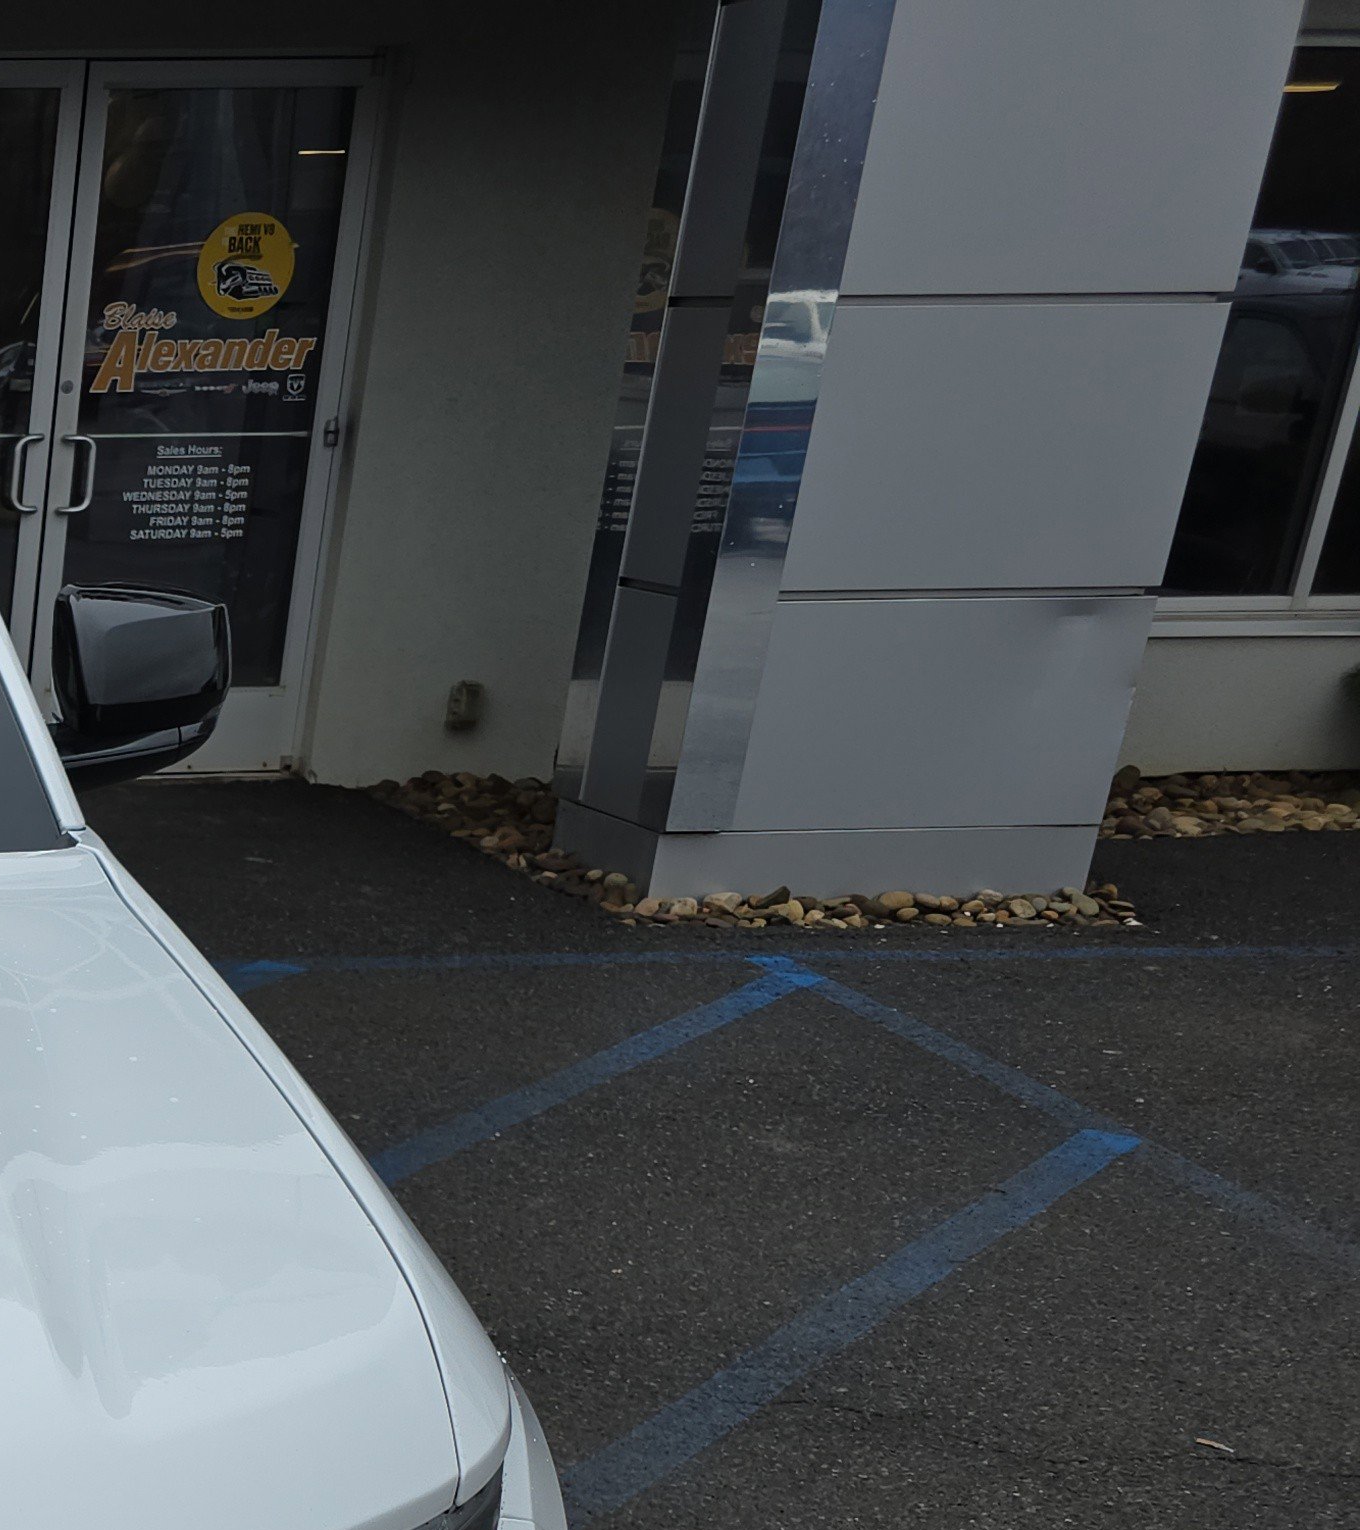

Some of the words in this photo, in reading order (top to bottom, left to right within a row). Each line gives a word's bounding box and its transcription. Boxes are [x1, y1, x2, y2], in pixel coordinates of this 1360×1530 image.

[228, 236, 262, 254] BACK
[102, 301, 177, 330] Blaise
[89, 328, 317, 393] Alexander
[157, 446, 185, 455] Sales
[188, 445, 222, 455] Hours:
[147, 465, 194, 475] MONDAY
[197, 465, 219, 474] 9am
[143, 478, 193, 488] TUESDAY
[195, 478, 217, 487] 9am
[123, 491, 191, 501] WEDNESDAY
[194, 491, 216, 500] 9am
[132, 504, 191, 514] THURSDAY
[193, 504, 214, 513] 9am
[149, 516, 189, 526] FRIDAY
[191, 516, 213, 526] 9am
[130, 529, 188, 540] SATURDAY
[190, 529, 212, 539] 9am
[221, 528, 243, 539] 5pm
